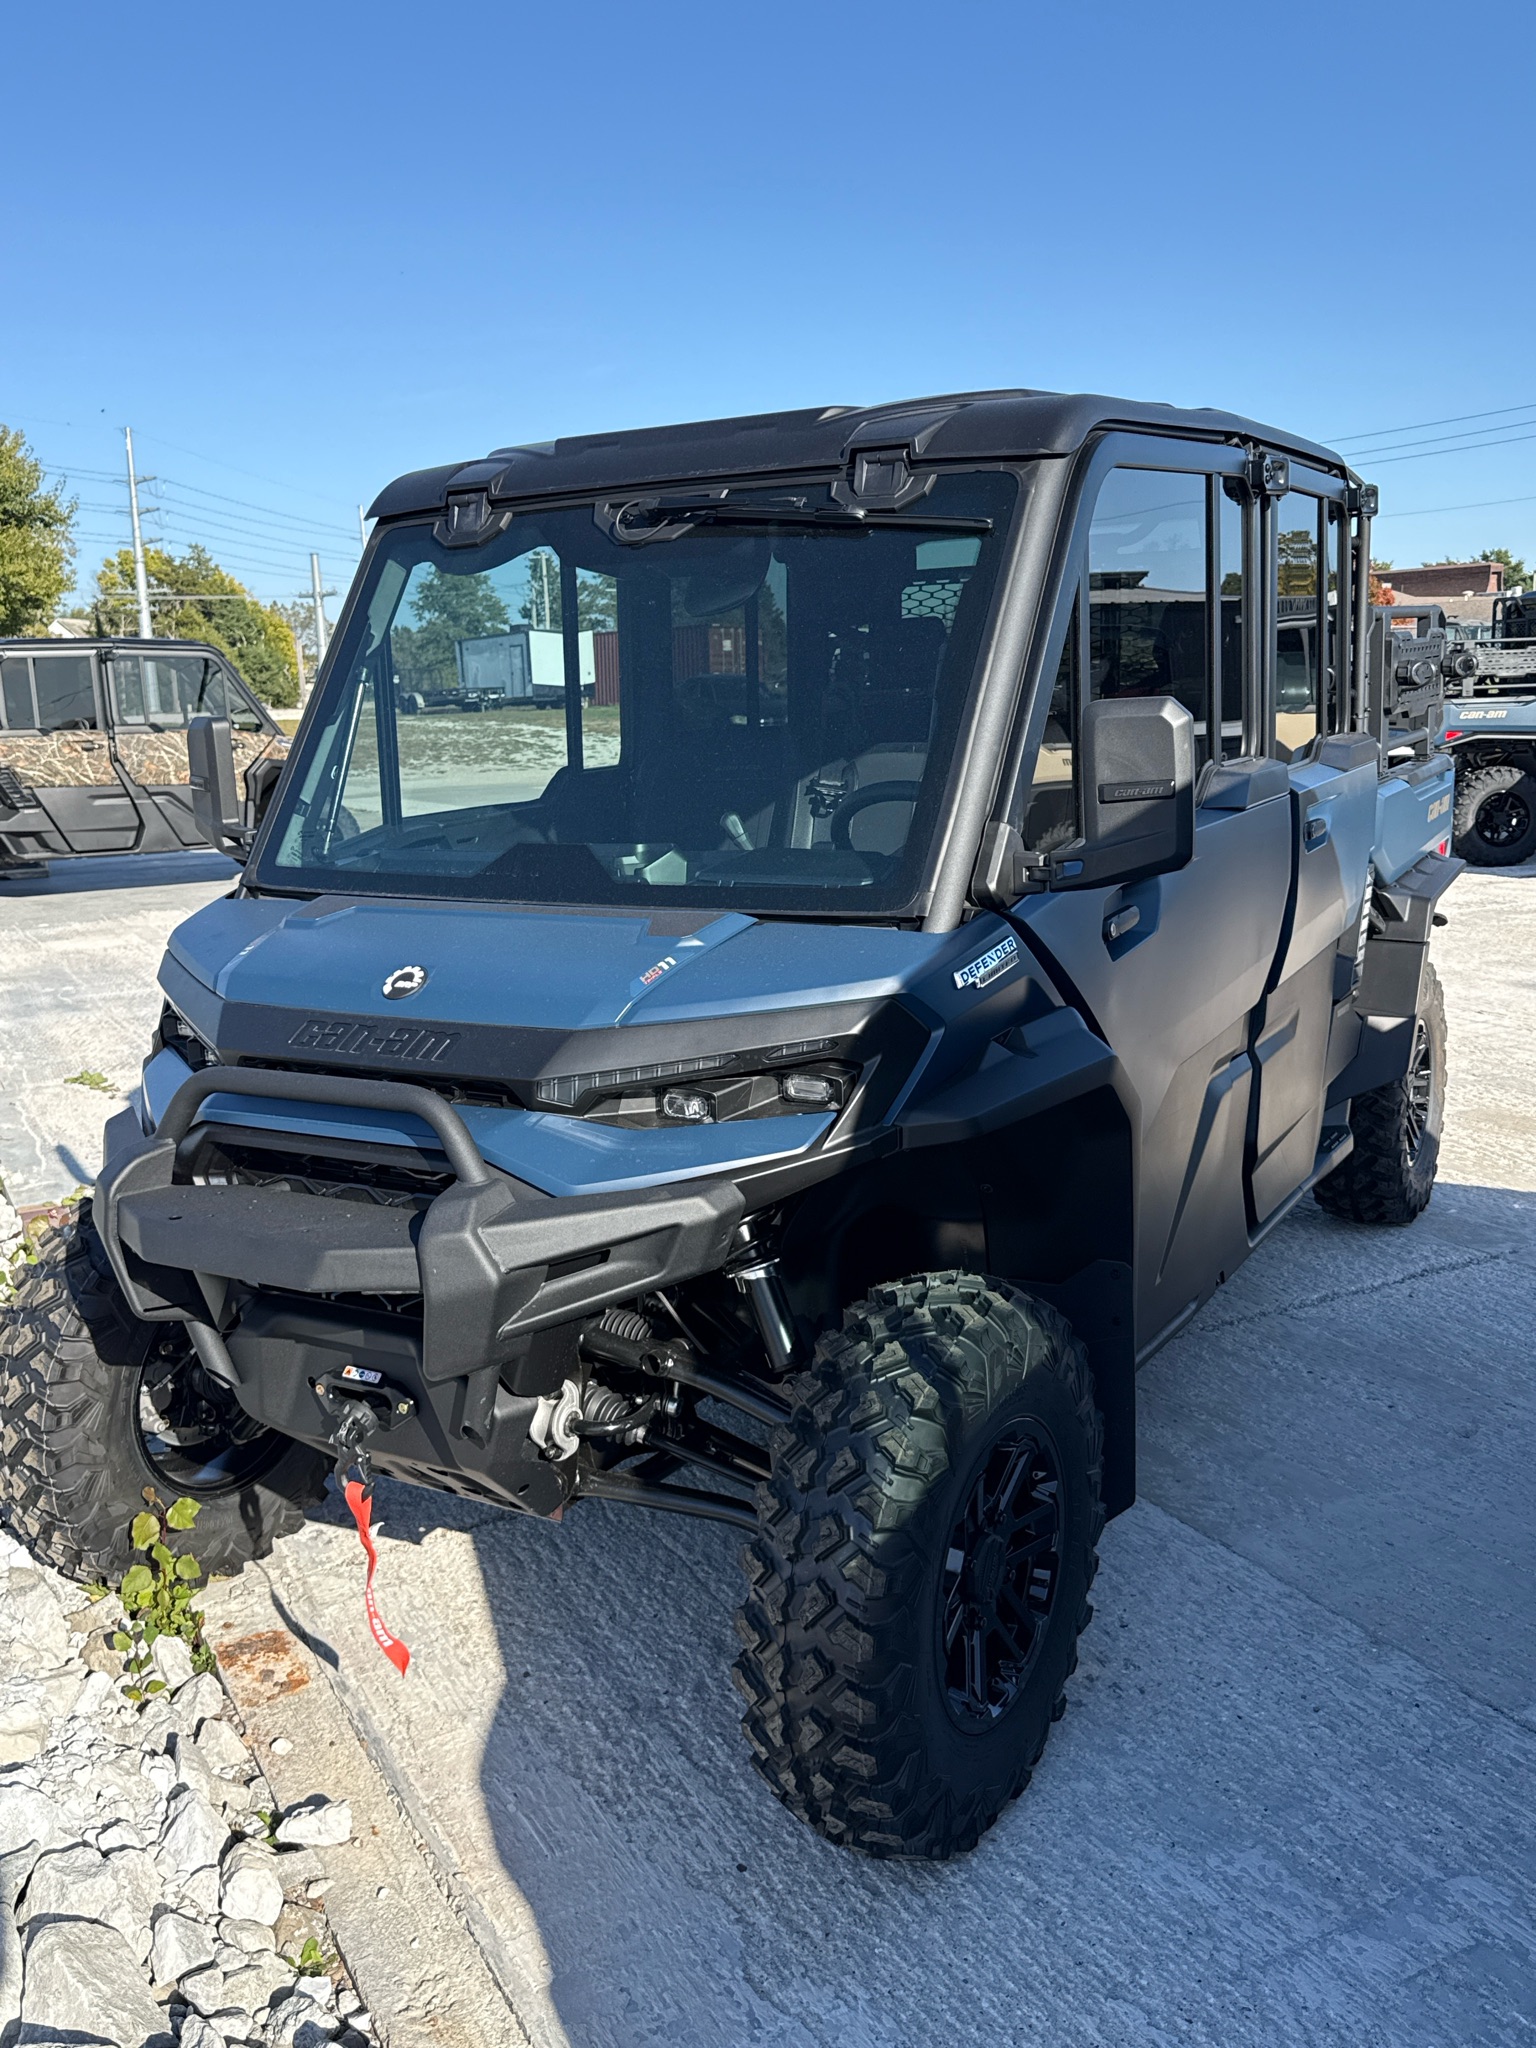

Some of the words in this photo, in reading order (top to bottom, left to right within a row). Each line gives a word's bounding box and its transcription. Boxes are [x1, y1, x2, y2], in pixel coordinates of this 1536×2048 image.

[1459, 710, 1507, 720] can-am
[1113, 786, 1164, 797] can-am
[960, 939, 1016, 983] DEFENDER
[288, 1020, 462, 1062] can-am
